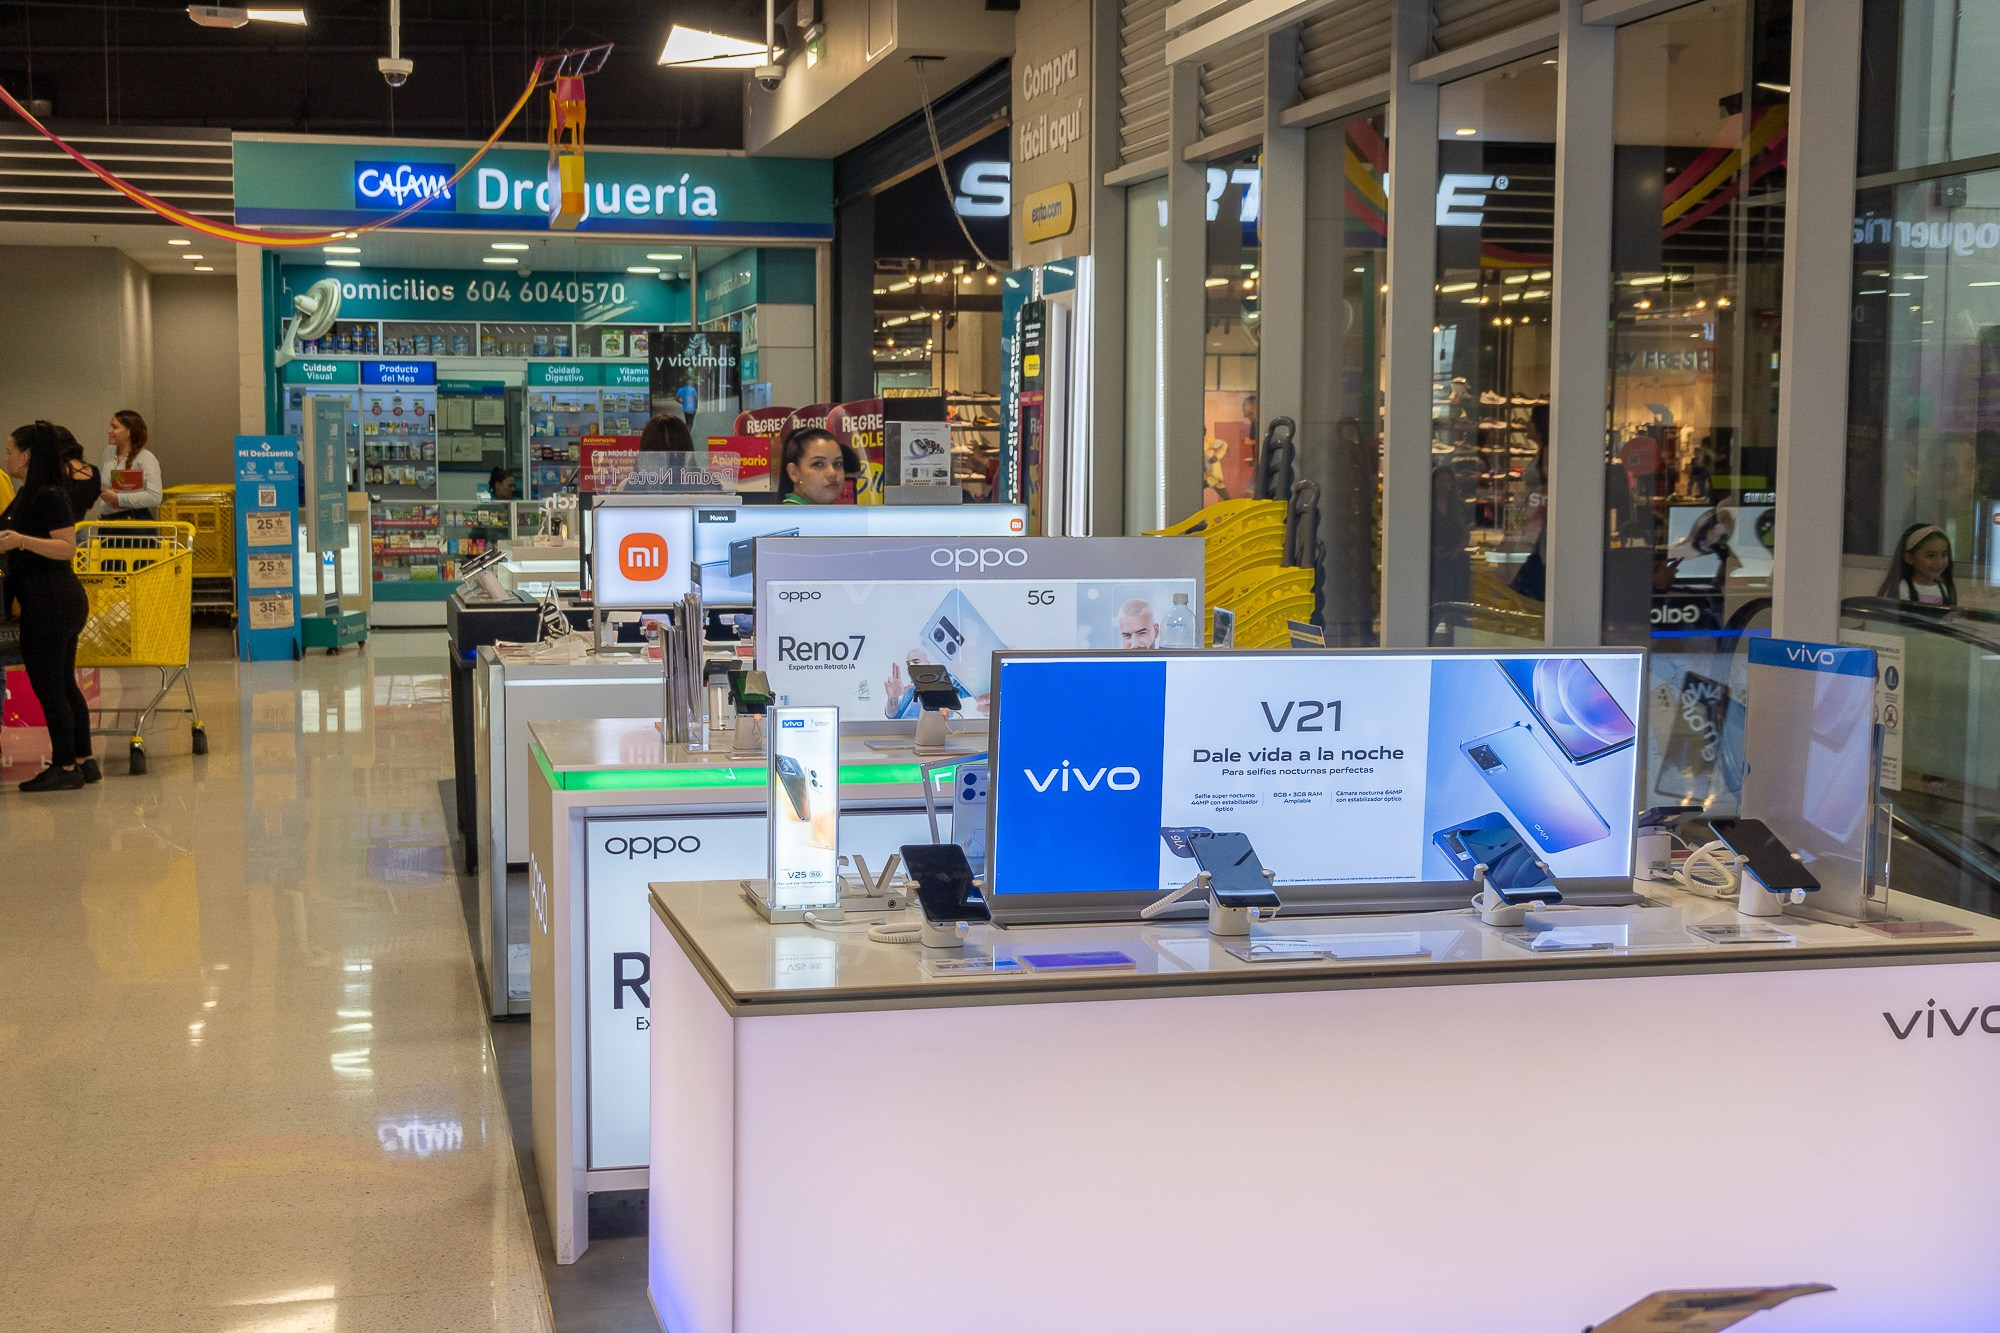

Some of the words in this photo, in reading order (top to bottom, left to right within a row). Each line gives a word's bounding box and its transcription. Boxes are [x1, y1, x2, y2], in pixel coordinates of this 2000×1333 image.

[1023, 48, 1079, 101] Compra
[1019, 114, 1048, 163] fácil
[1050, 97, 1082, 154] aquí
[478, 167, 718, 222] Drouería
[341, 278, 455, 302] omicilios
[466, 280, 512, 302] 604
[520, 281, 625, 304] 6040570
[303, 363, 337, 373] Cuidado
[655, 355, 664, 371] y
[379, 364, 419, 375] Producto
[548, 366, 581, 375] Cuidado
[307, 372, 333, 381] Visual
[381, 374, 396, 383] del
[397, 374, 416, 383] Mes
[545, 373, 584, 384] Digestivo
[239, 450, 249, 458] Mi
[250, 450, 294, 458] Descuento
[711, 455, 768, 467] Aniversario
[710, 514, 729, 522] Nueva
[256, 519, 274, 530] 25
[930, 547, 1028, 573] oppo
[258, 561, 275, 572] 25
[778, 590, 821, 603] oppo
[1027, 590, 1056, 606] 5G
[259, 602, 277, 613] 35
[778, 635, 866, 661] Reno7
[1787, 645, 1834, 665] vivo
[789, 664, 814, 672] Experto
[1261, 700, 1342, 733] V21
[1193, 747, 1242, 763] Dale
[1248, 747, 1292, 763] vida
[1299, 750, 1312, 762] a
[1318, 747, 1334, 762] la
[1341, 746, 1404, 761] noche
[1023, 759, 1141, 793] vivo
[1222, 768, 1244, 776] Para
[1246, 768, 1277, 776] selfies
[1279, 767, 1326, 776] nocturnas
[1329, 766, 1374, 776] perfectas
[1534, 824, 1549, 841] vivo
[605, 835, 701, 859] oppo
[788, 871, 807, 879] V25
